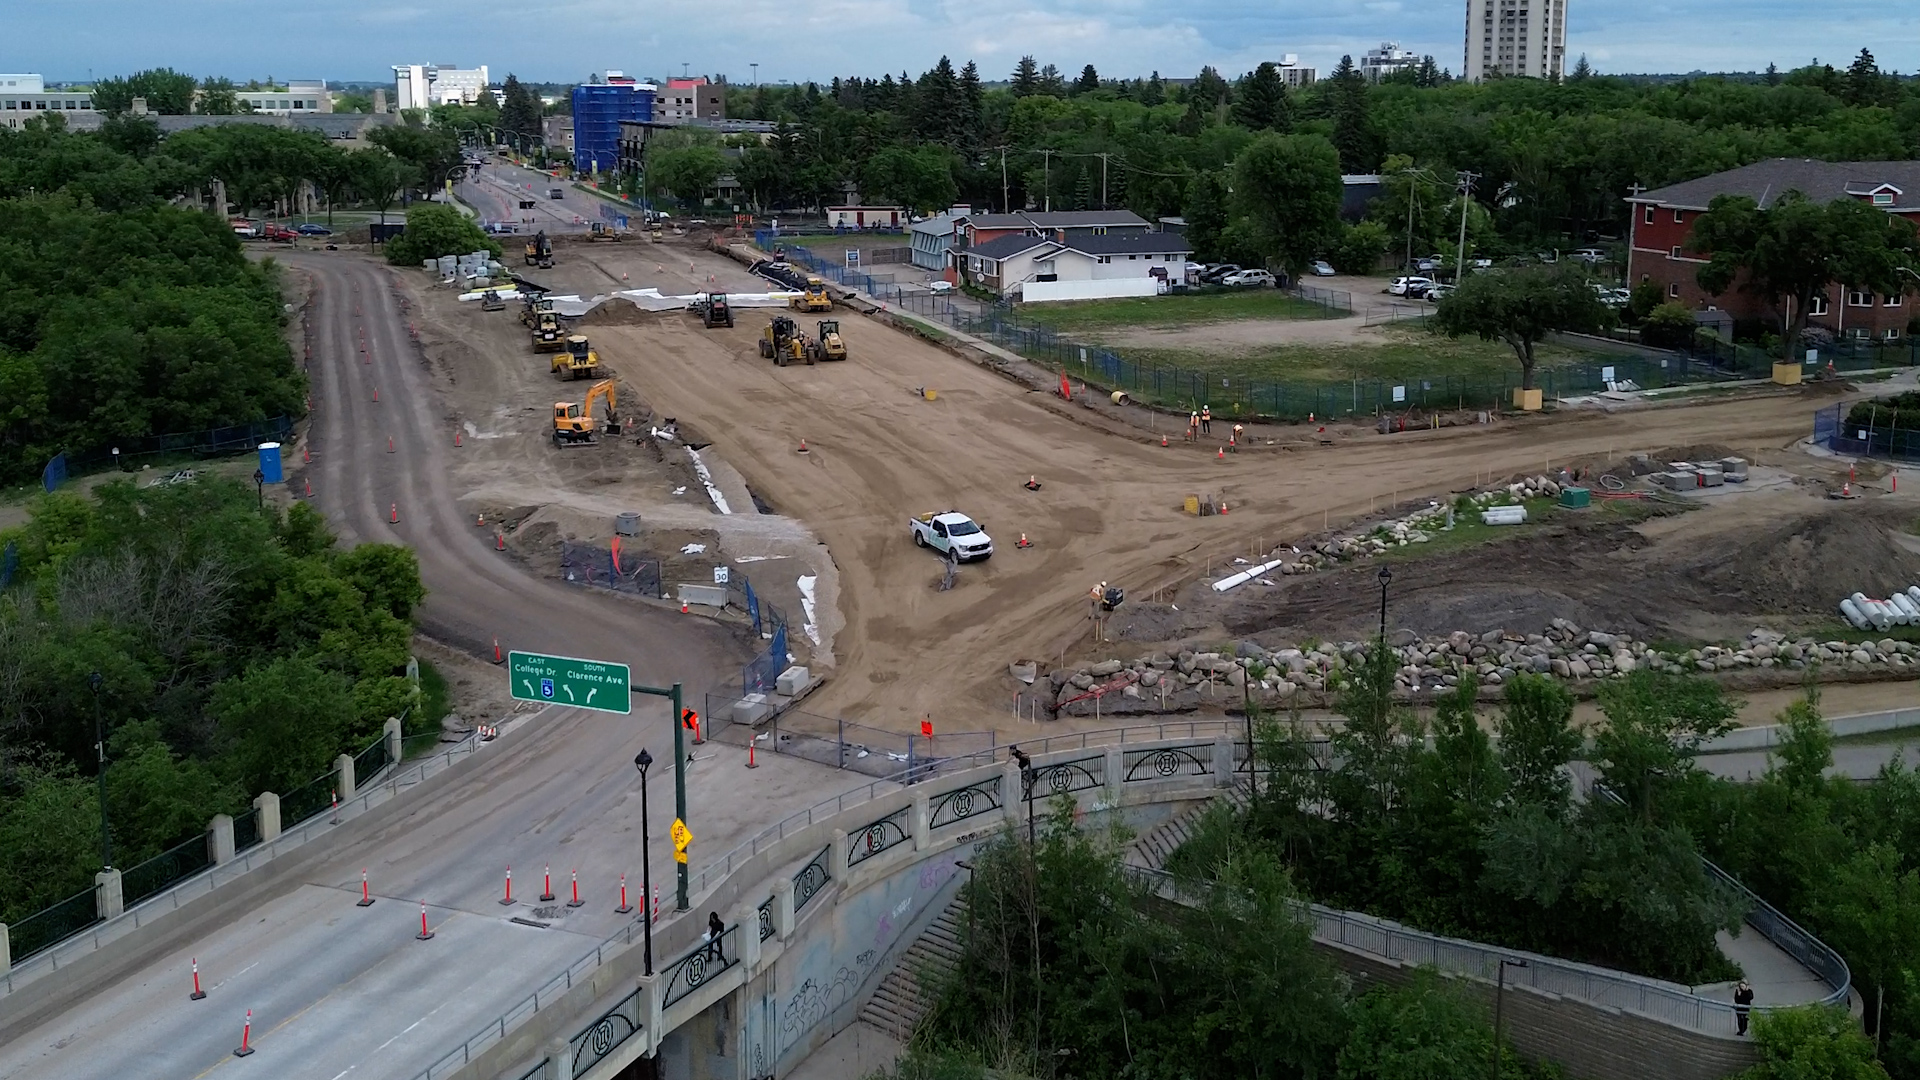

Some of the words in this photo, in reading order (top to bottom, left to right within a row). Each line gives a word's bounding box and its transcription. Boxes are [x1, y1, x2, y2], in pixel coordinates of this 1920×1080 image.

[716, 573, 727, 581] 30
[528, 657, 545, 665] EAST
[515, 664, 544, 676] College
[546, 668, 557, 677] Dr.
[584, 664, 606, 672] SOUTH
[567, 670, 603, 683] Clarence
[606, 675, 625, 686] Ave.
[544, 686, 552, 695] 5
